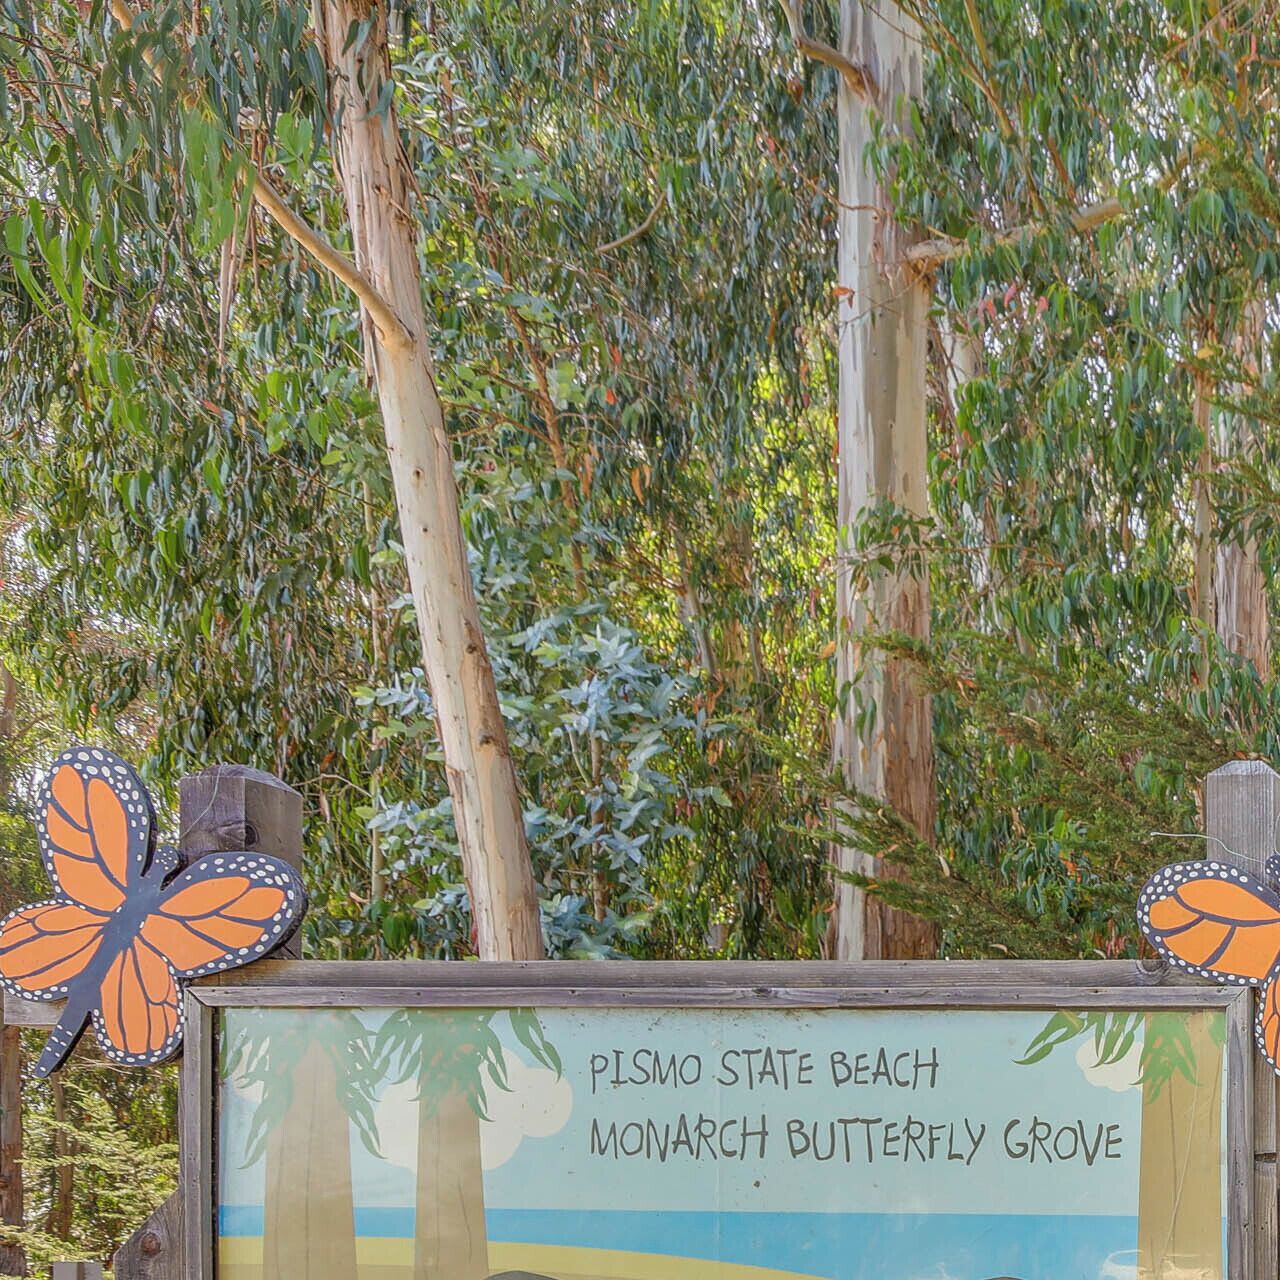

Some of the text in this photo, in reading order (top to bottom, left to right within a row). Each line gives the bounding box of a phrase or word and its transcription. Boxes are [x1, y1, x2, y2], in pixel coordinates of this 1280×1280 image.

[590, 1046, 939, 1095] PISMO STATE BEACH
[590, 1113, 1123, 1167] MONARCH BUTTERFLY GROVE
